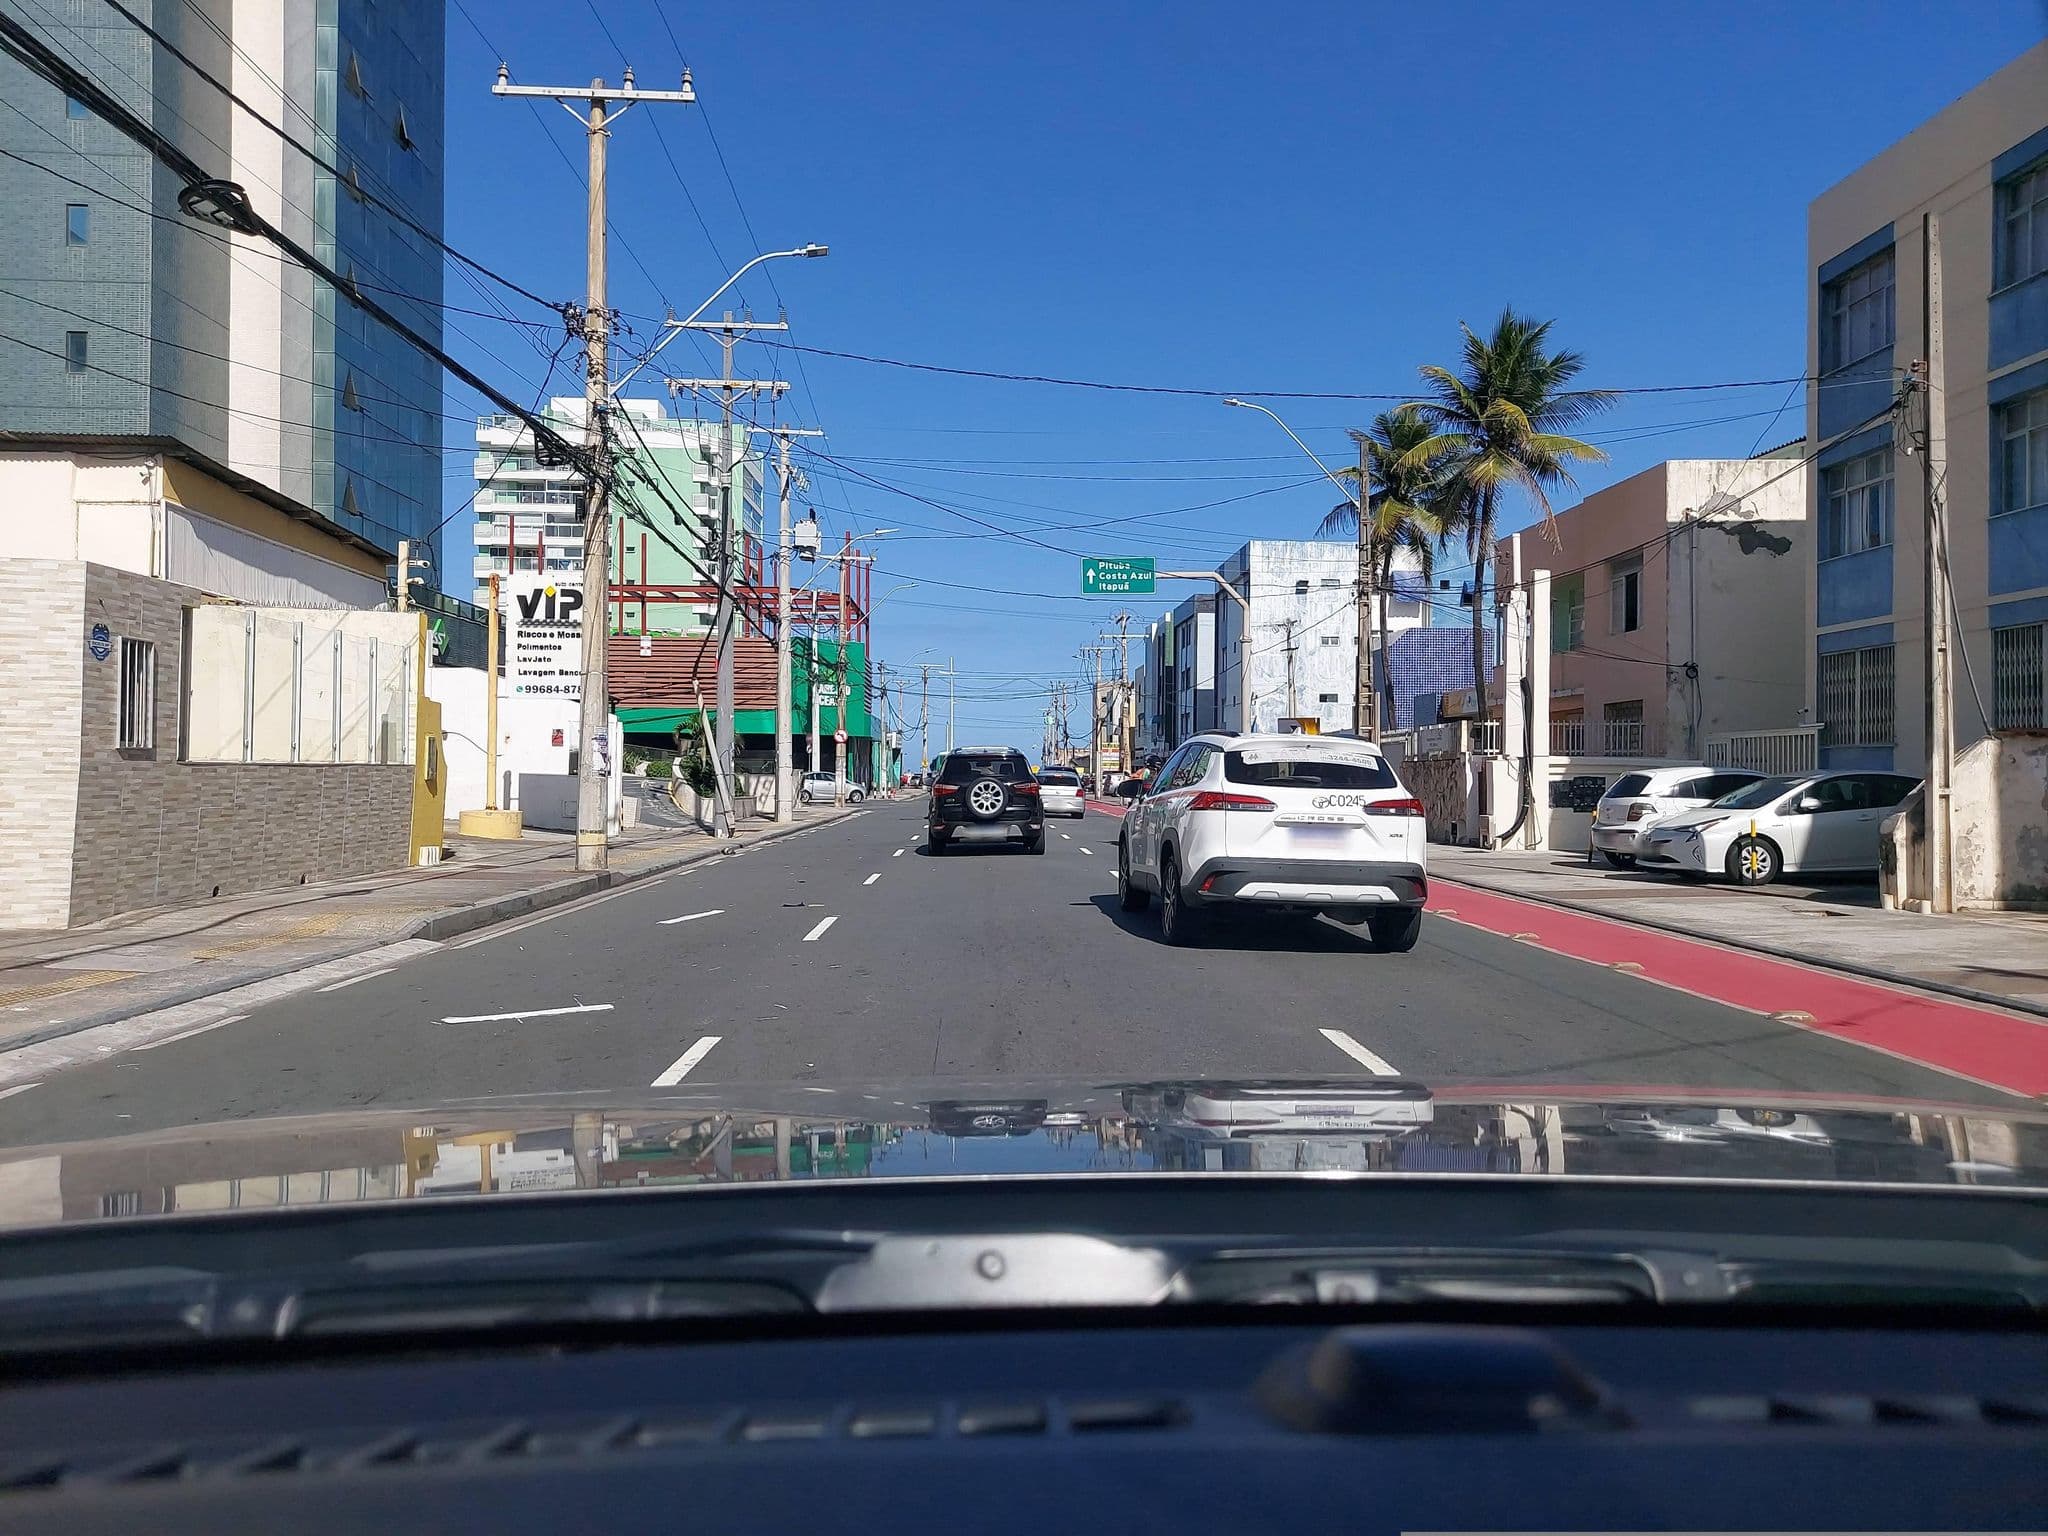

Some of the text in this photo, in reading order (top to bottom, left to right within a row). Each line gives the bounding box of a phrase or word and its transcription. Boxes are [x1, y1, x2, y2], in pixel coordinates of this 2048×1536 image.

[1099, 561, 1131, 570] Pituba
[1099, 571, 1152, 580] Costa Azul
[1099, 582, 1130, 592] Itapuã
[517, 630, 547, 638] Riscos
[557, 630, 582, 639] Moss
[517, 643, 562, 651] Polimentos
[517, 655, 552, 663] LavJato
[518, 668, 556, 677] Lavagem
